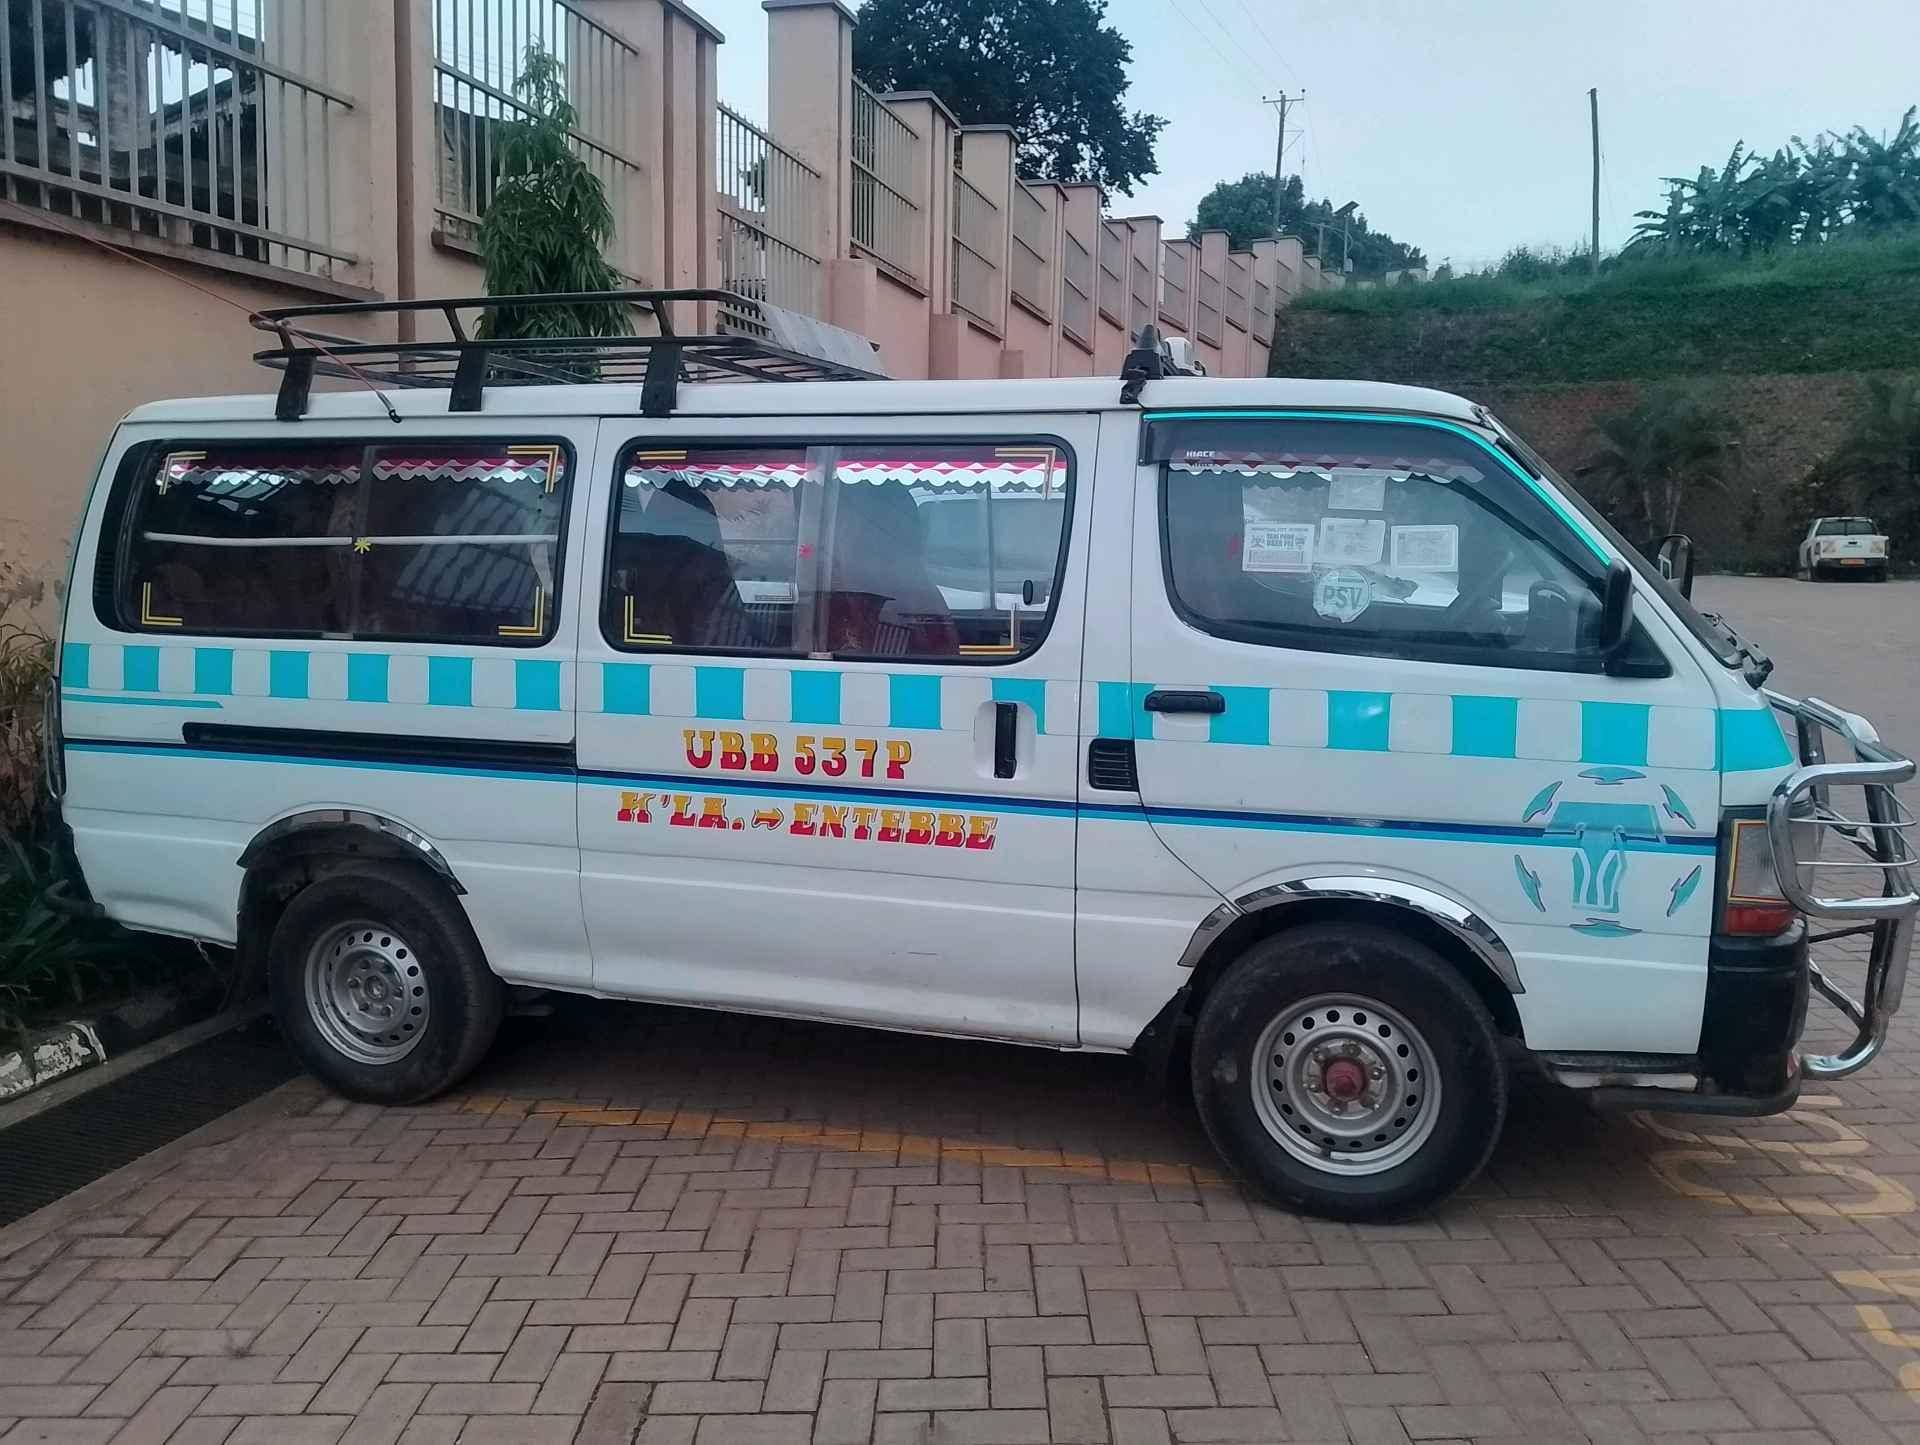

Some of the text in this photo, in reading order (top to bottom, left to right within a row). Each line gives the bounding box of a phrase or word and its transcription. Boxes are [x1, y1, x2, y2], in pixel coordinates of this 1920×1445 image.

[1322, 585, 1361, 609] PSV
[684, 730, 912, 780] UBB 537P
[617, 791, 999, 851] K'LA. ENTEBBE
